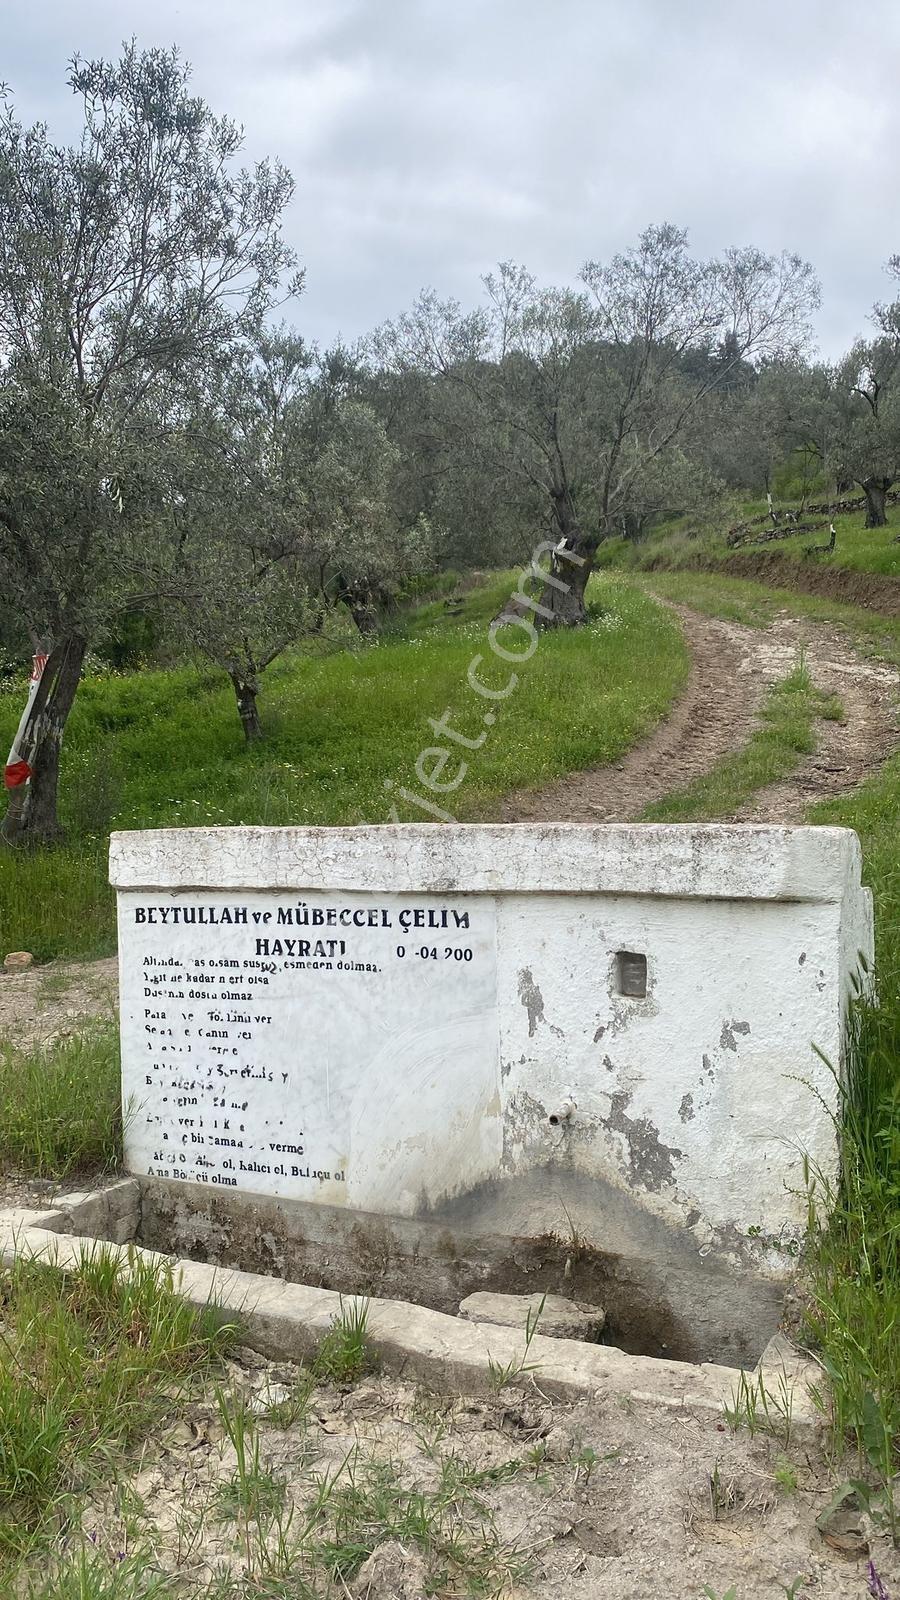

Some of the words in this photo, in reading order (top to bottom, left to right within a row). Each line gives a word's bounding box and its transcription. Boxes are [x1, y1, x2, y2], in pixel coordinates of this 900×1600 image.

[135, 907, 248, 925] BEYTULLAH
[252, 912, 272, 925] ve
[277, 901, 392, 928] MÜBECCEL
[221, 990, 253, 1001] olmaz
[254, 1015, 272, 1024] ver
[269, 1143, 305, 1155] verme
[222, 1158, 236, 1171] ol,
[334, 1170, 346, 1182] ol
[211, 1173, 238, 1186] olma
